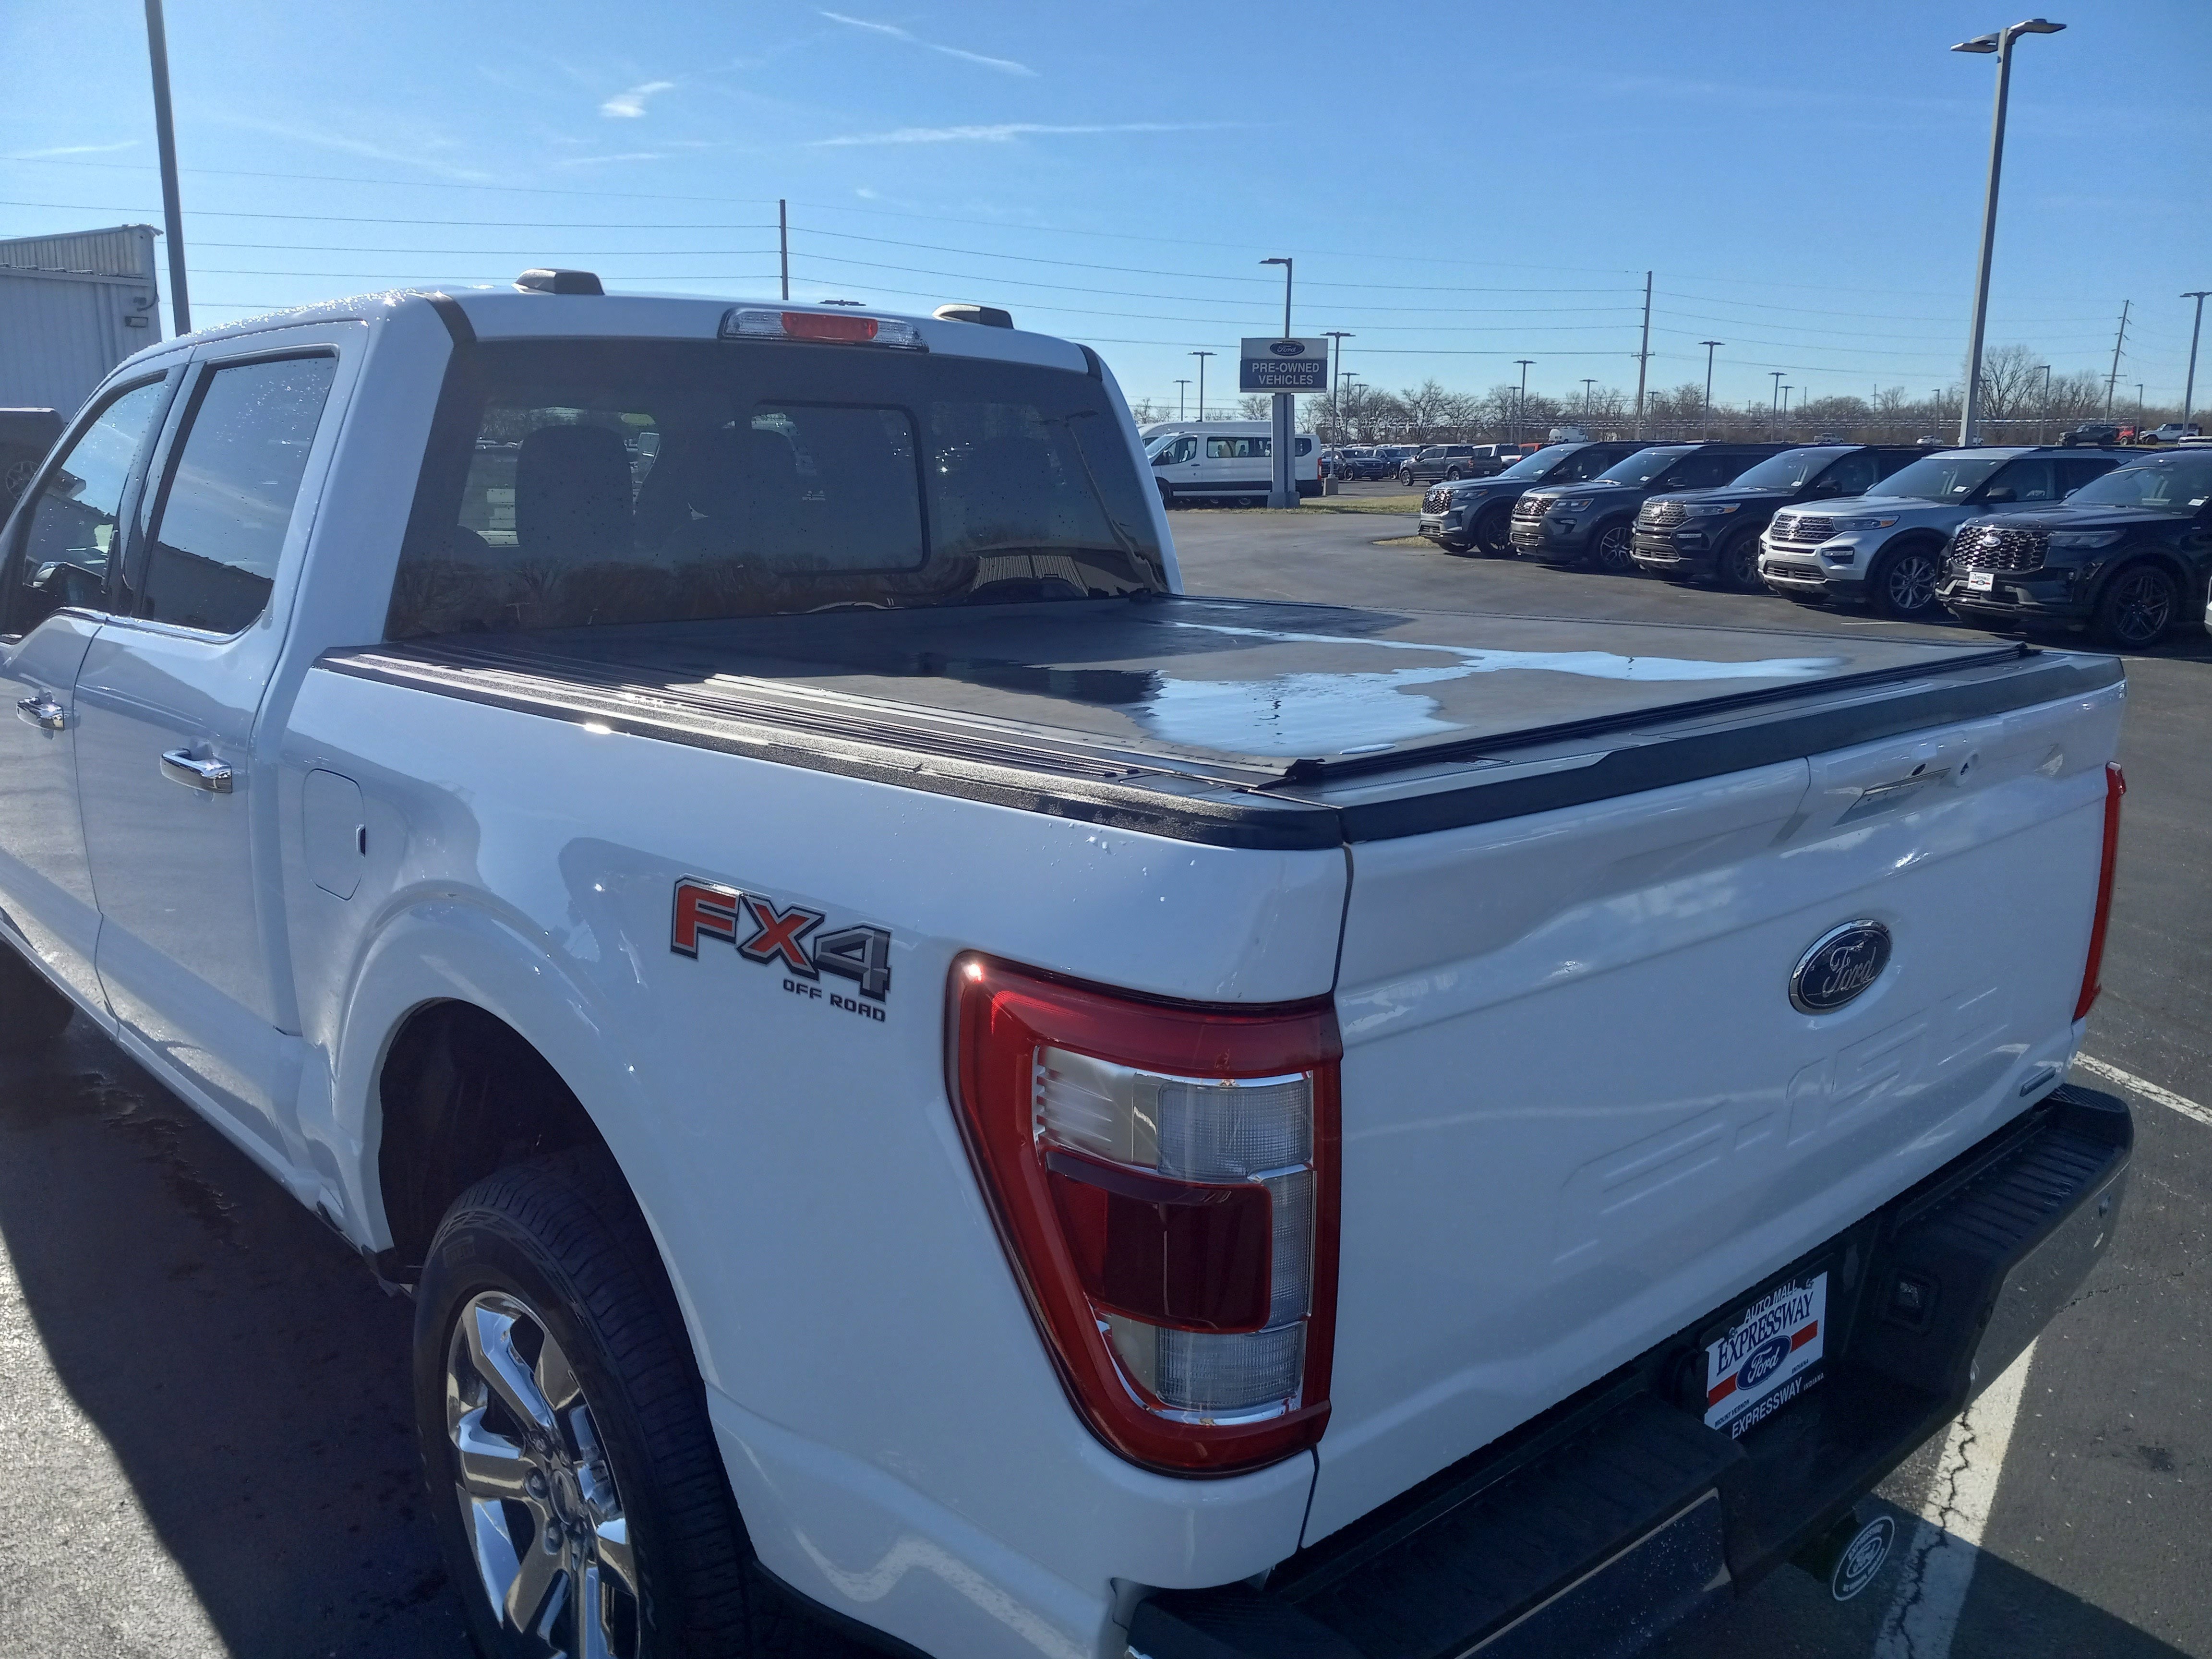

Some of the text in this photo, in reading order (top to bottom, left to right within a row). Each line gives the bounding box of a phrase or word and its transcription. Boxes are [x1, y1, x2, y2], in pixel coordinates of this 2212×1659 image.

[1252, 362, 1320, 373] PRE-OWNED
[1258, 374, 1313, 385] VEHICLES
[671, 873, 893, 1004] FX4
[1822, 940, 1877, 998] Ford
[783, 977, 886, 1022] OFF ROAD
[1744, 1279, 1798, 1324] AUTO MALL
[1716, 1291, 1814, 1377] EXPRESSWAY
[1747, 1346, 1780, 1384] Ford
[1803, 1372, 1824, 1391] INDIANA
[1731, 1376, 1803, 1440] EXPRESSWAY
